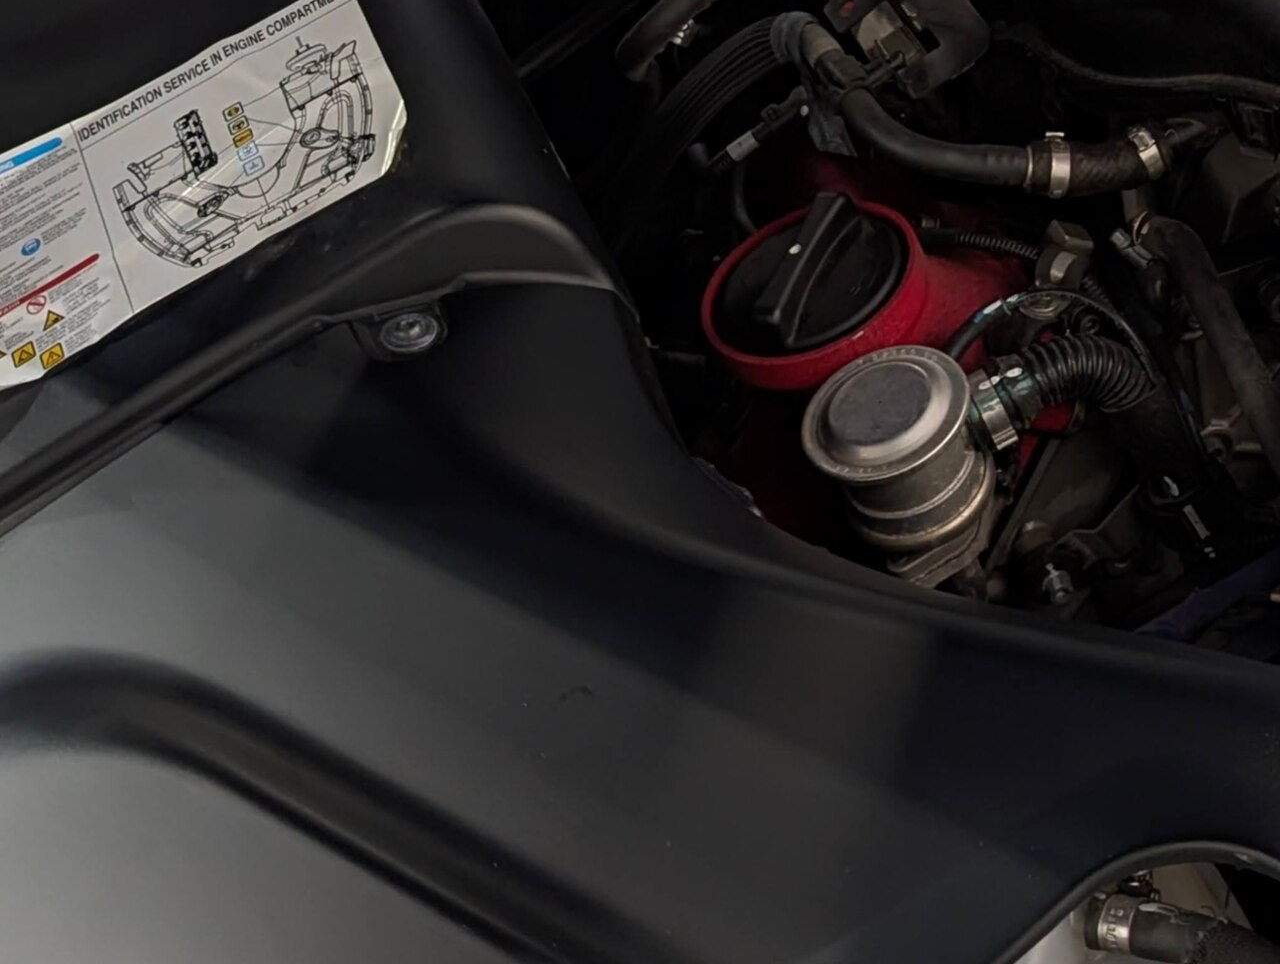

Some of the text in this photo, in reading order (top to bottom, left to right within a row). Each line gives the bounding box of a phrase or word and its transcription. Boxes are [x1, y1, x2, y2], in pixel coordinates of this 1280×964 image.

[77, 86, 162, 142] IDENTIFICATION
[163, 59, 211, 94] SERVICE
[210, 50, 222, 67] IN
[223, 29, 266, 58] ENGINE
